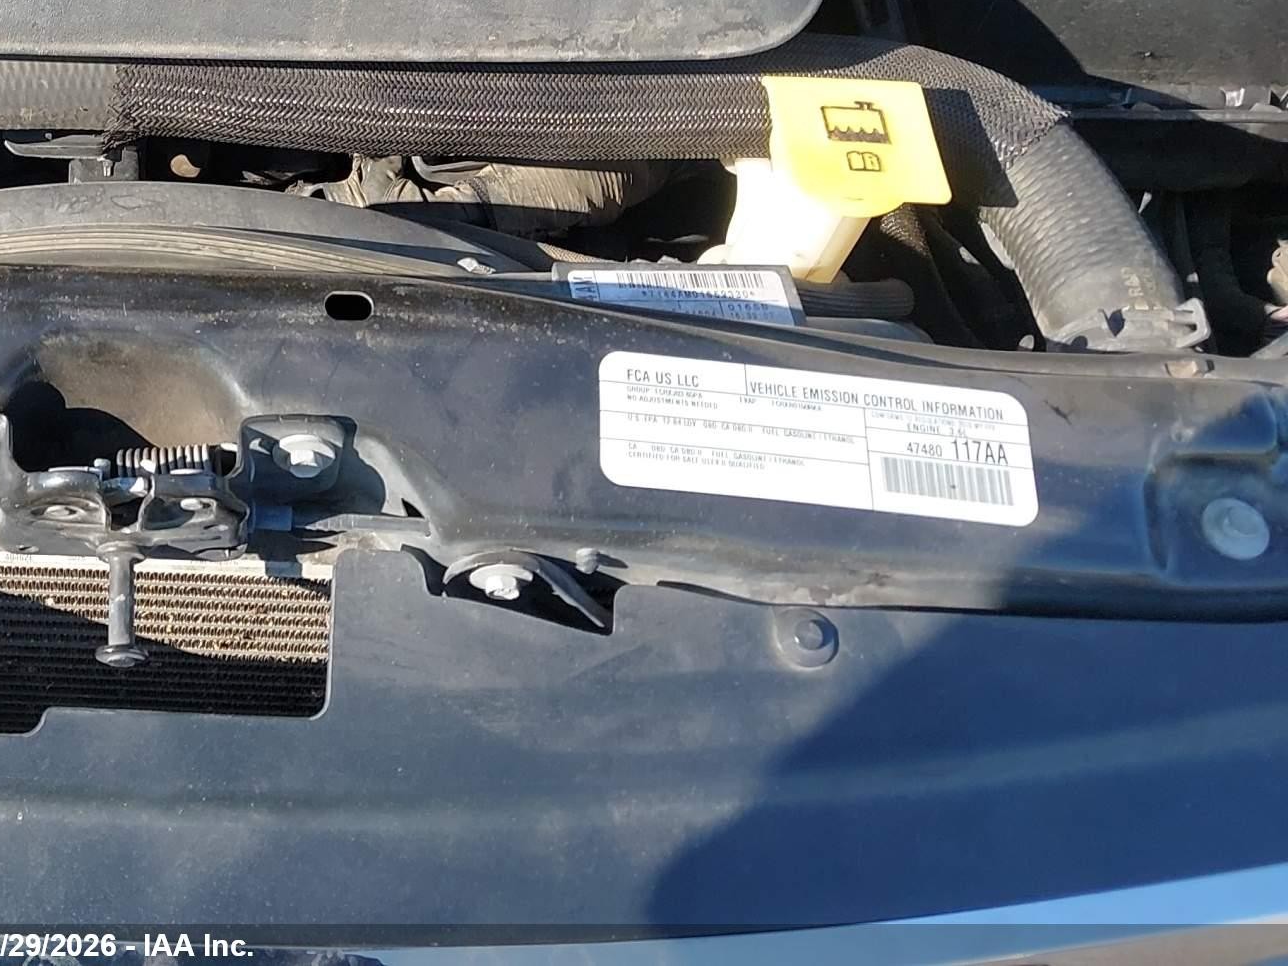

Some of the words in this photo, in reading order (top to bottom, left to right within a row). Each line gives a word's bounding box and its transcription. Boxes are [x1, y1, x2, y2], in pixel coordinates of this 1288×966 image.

[626, 369, 650, 382] FCA
[655, 371, 672, 385] US
[677, 373, 699, 387] LLC
[750, 381, 798, 399] VEHICLE
[803, 386, 858, 404] EMISSION
[863, 393, 917, 411] CONTROL
[922, 401, 1004, 420] INFORMATION
[907, 422, 941, 433] ENGINE
[906, 442, 942, 457] 47480
[952, 438, 1009, 464] 117AA
